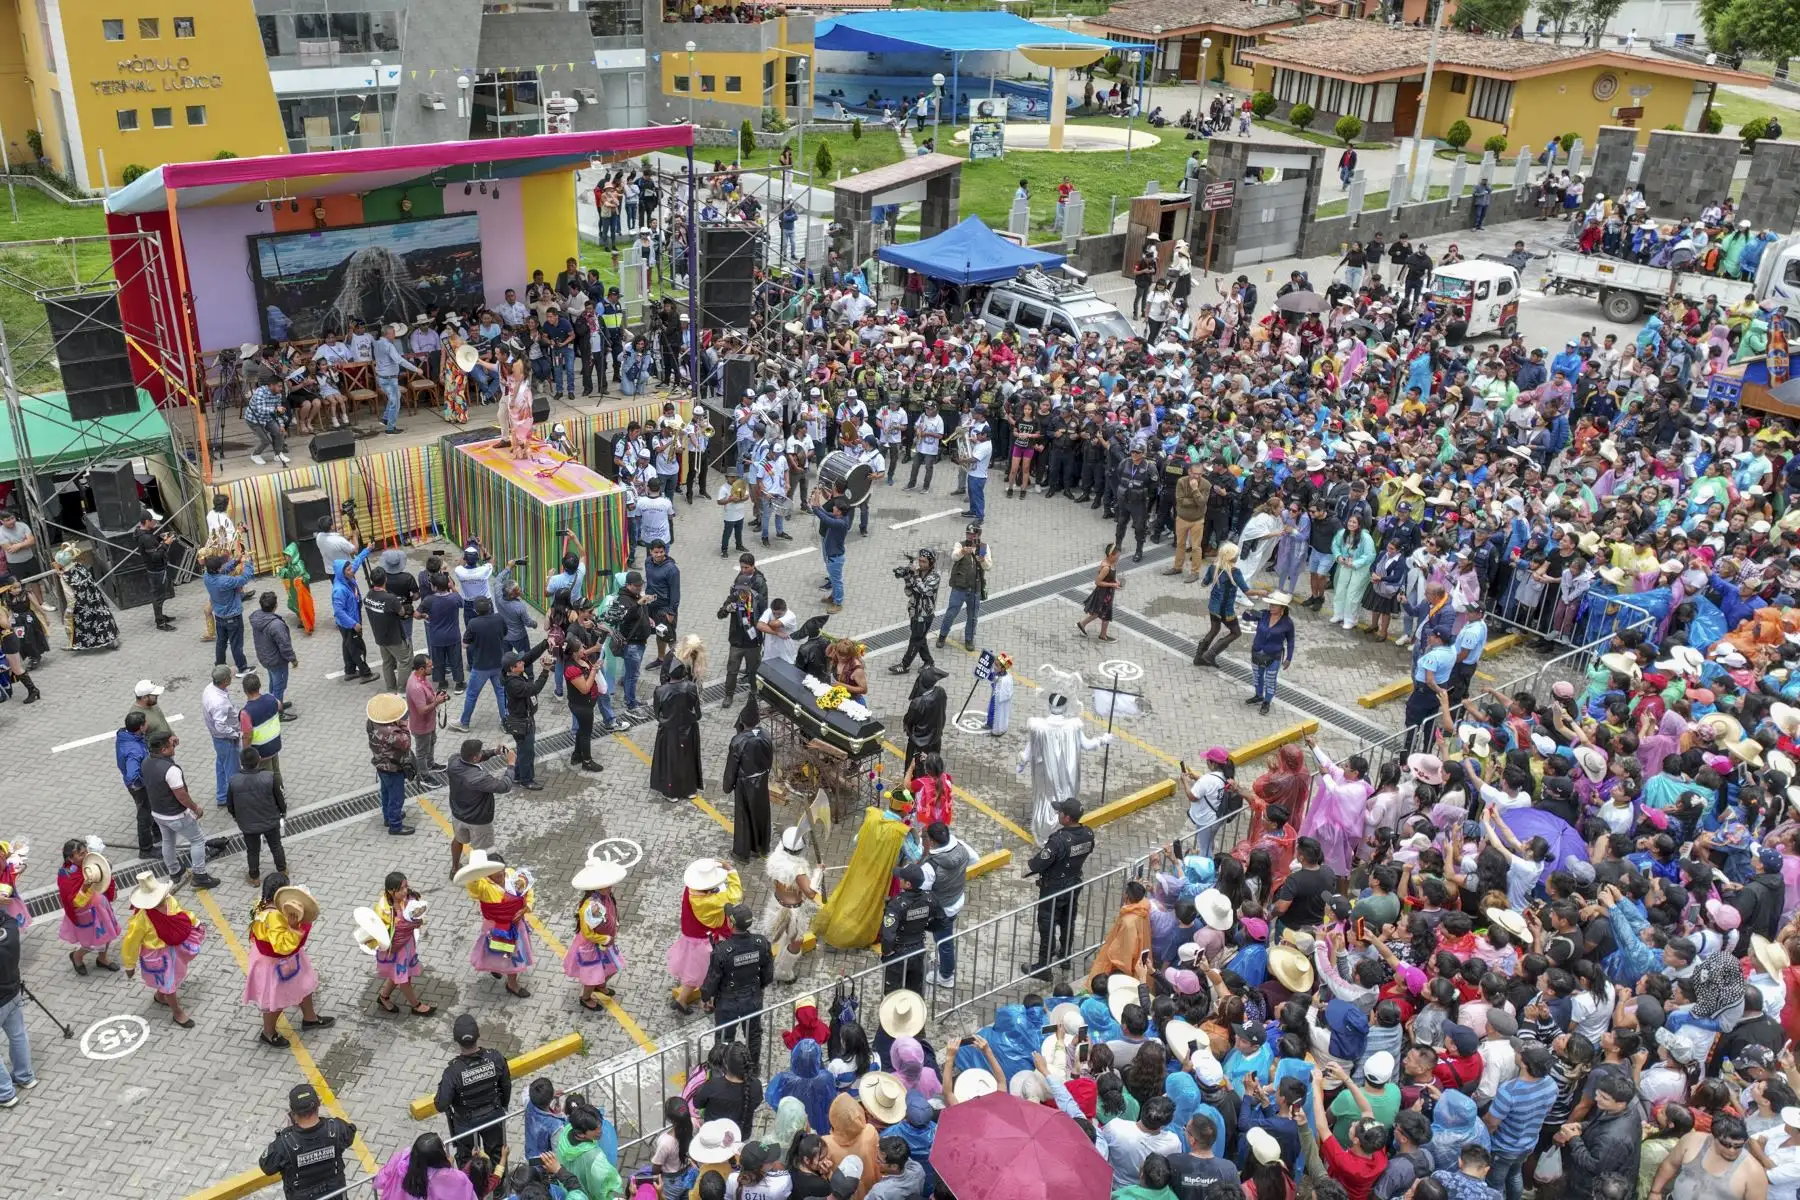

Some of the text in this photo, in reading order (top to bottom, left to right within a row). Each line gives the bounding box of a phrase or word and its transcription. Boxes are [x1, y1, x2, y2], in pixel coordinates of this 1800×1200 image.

[117, 54, 190, 73] MÓDULO
[162, 71, 223, 92] LÚDICO
[98, 1024, 138, 1052] 15
[463, 1062, 494, 1078] SERENAZGO
